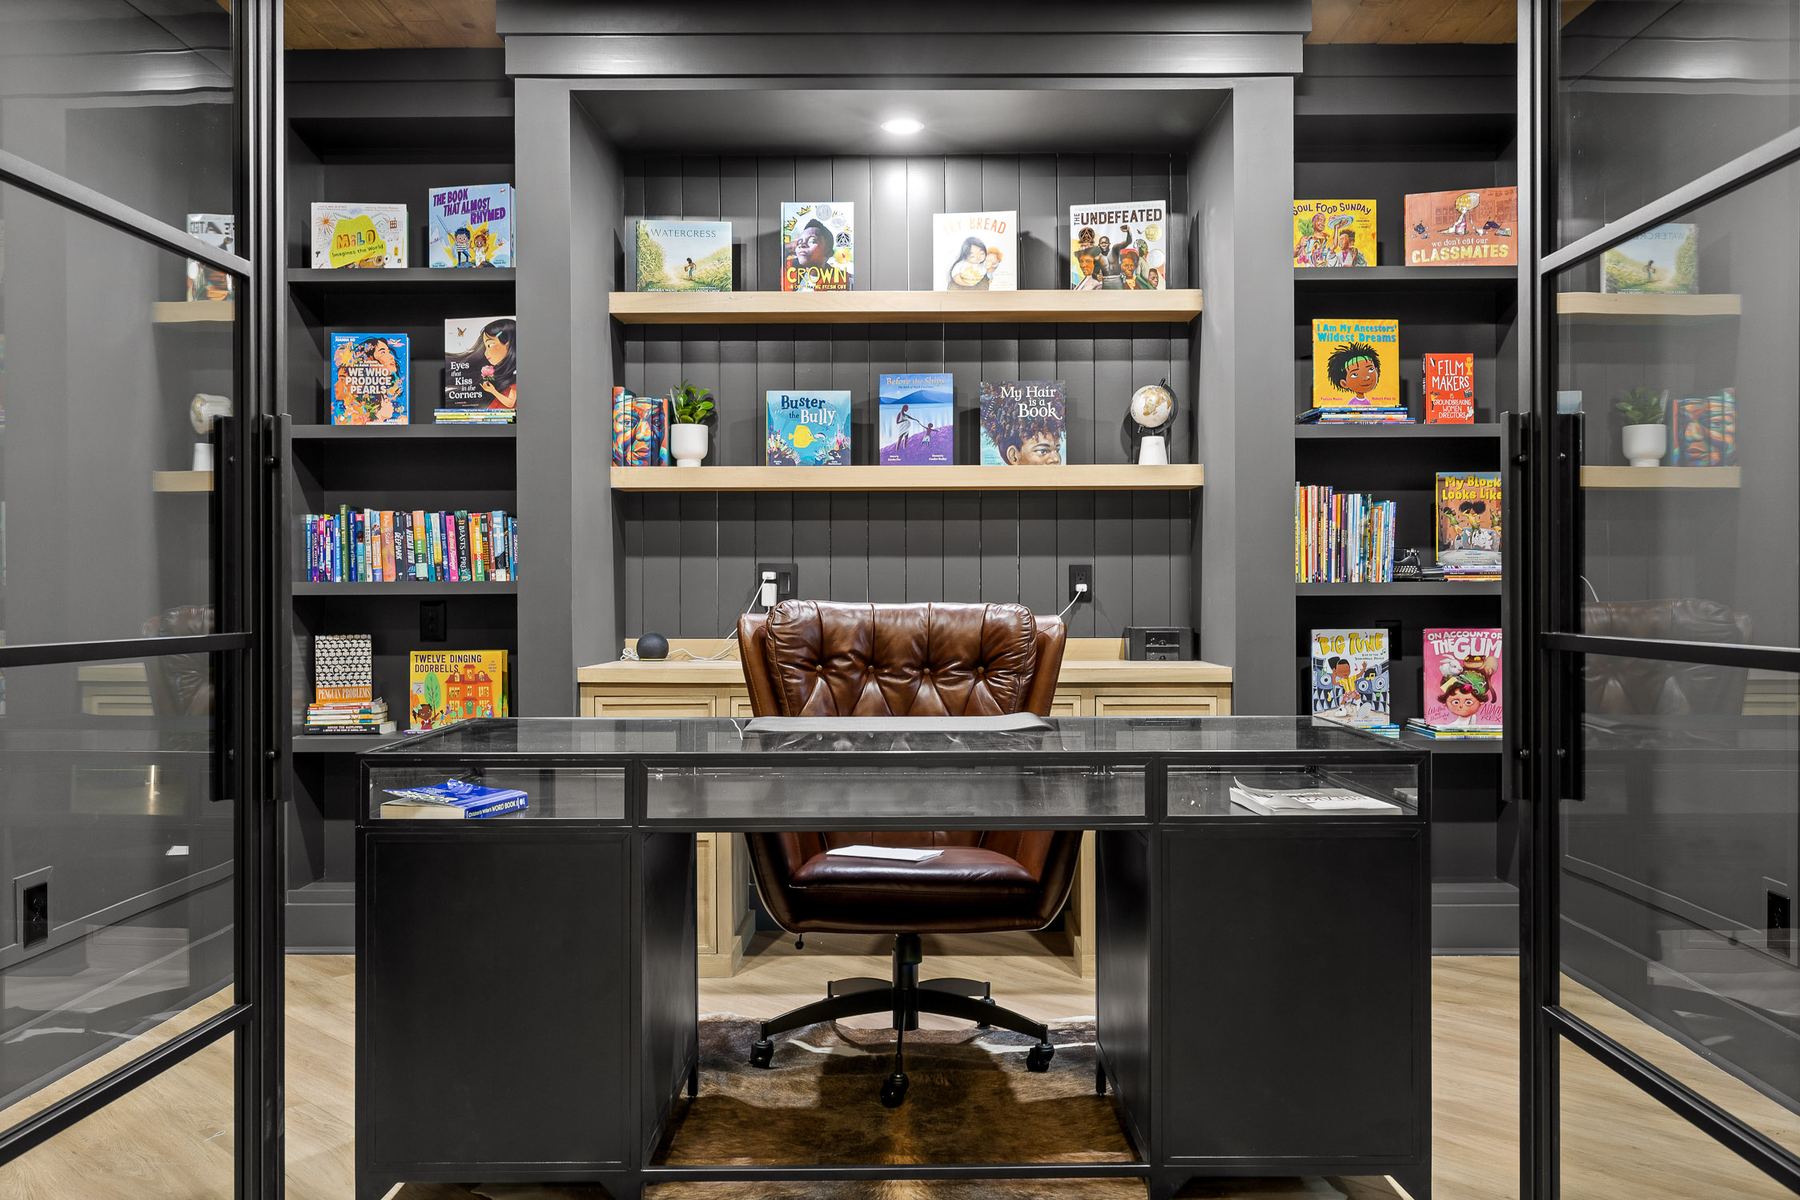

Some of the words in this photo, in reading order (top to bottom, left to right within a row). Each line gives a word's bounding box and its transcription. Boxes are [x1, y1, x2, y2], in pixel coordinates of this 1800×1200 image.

[432, 192, 447, 207] THE
[448, 188, 468, 203] BOOK
[443, 202, 460, 217] THAT
[460, 197, 491, 214] ALMOST
[1294, 203, 1314, 216] SOUL
[1316, 202, 1338, 214] FOOD
[1339, 202, 1372, 216] SUNDAY
[470, 206, 506, 225] RHYMED
[1073, 212, 1081, 226] THE
[1080, 208, 1163, 225] UNDEFEATED
[969, 217, 1007, 234] BREAD
[650, 228, 717, 238] WATERCRESS
[1443, 237, 1460, 246] don't
[1462, 238, 1474, 246] eat
[1411, 244, 1510, 264] CLASSMATES
[786, 266, 847, 284] CROWN
[1316, 324, 1321, 332] I
[1322, 324, 1337, 332] Am
[1339, 324, 1351, 334] My
[1317, 332, 1356, 342] Wildest
[1358, 332, 1397, 342] Dreams
[348, 368, 364, 376] WE
[365, 368, 388, 376] WHO
[450, 362, 470, 372] Eyes
[1438, 360, 1464, 376] FILM
[346, 376, 392, 386] PRODUCE
[455, 377, 473, 386] Kiss
[1432, 376, 1470, 391] MAKERS
[350, 386, 387, 394] PEARLS
[448, 391, 483, 399] Corners
[1000, 386, 1022, 401] My
[1026, 386, 1057, 398] Hair
[781, 395, 826, 410] Buster
[1028, 398, 1036, 406] is
[789, 410, 800, 419] the
[800, 408, 836, 426] Bully
[1018, 402, 1063, 420] Book
[1444, 476, 1465, 491] My
[1467, 476, 1502, 488] Block
[1442, 488, 1478, 500] Looks
[1479, 488, 1502, 500] Like
[1490, 632, 1502, 640] OF
[1348, 632, 1384, 656] TUNE
[1430, 638, 1455, 656] THE
[1454, 638, 1502, 660] GUM
[414, 654, 446, 664] TWELVE
[450, 654, 482, 663] DINGING
[414, 664, 459, 673] DOORBELLS
[318, 688, 342, 699] PENGUIN
[342, 687, 371, 698] PROBLEMS
[504, 800, 516, 810] BOOK
